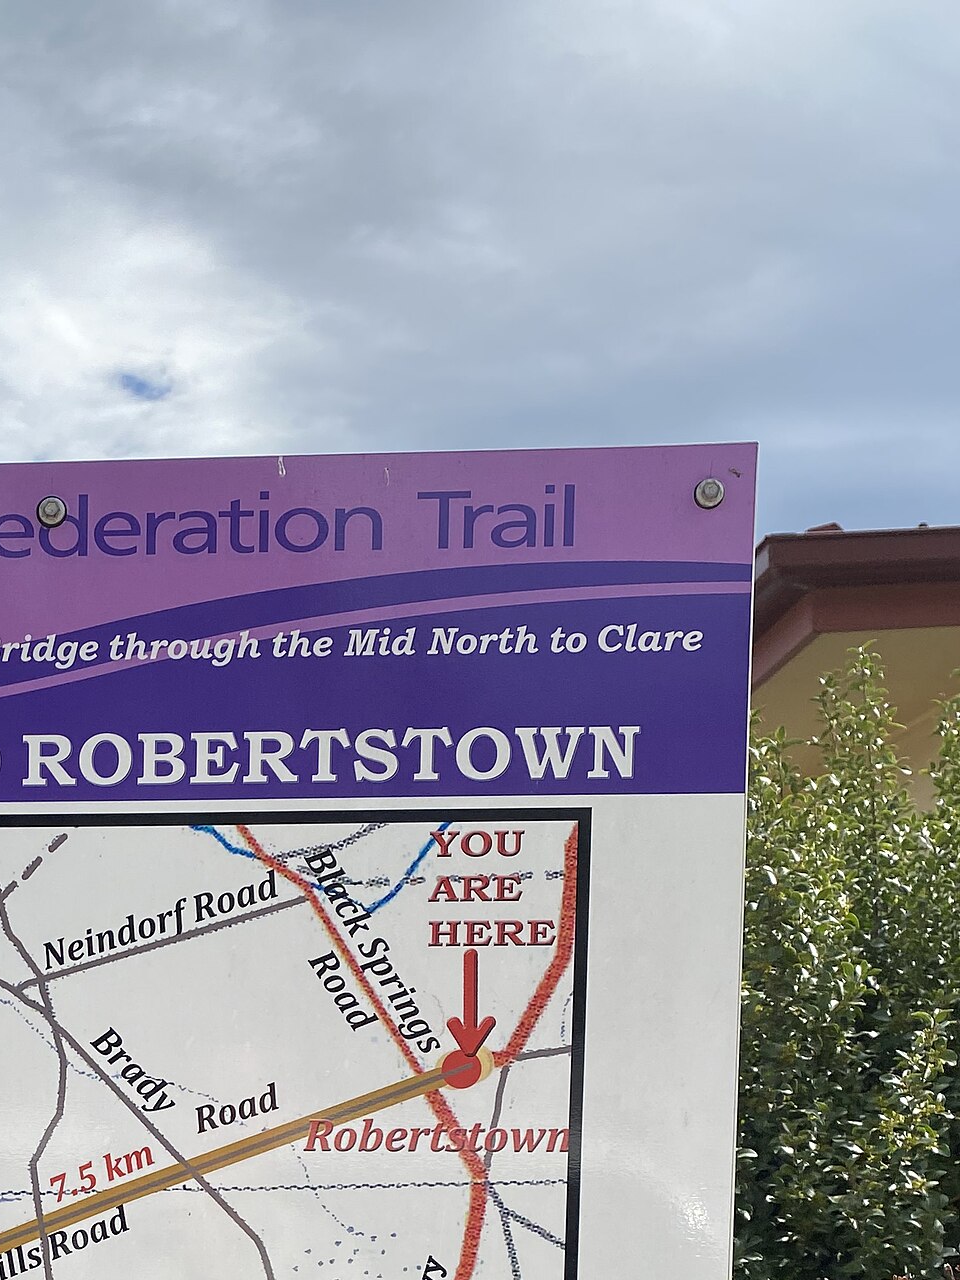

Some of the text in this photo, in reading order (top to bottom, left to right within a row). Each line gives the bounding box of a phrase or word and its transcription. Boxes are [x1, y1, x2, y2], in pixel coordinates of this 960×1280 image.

[417, 484, 576, 549] Trail
[109, 631, 261, 666] through
[272, 629, 333, 658] the
[343, 628, 415, 656] Mid
[427, 626, 541, 655] North
[550, 628, 588, 653] to
[597, 623, 703, 653] Clare
[21, 725, 641, 787] ROBERTSTOWN
[430, 829, 525, 858] YOU
[427, 875, 522, 902] ARE
[42, 870, 279, 970] Neindorf Road
[427, 919, 556, 947] HERE
[304, 848, 442, 1053] Black Springs
[308, 950, 376, 1032] Road
[90, 1026, 176, 1113] Brady
[194, 1083, 280, 1134] Road
[303, 1119, 569, 1152] Robertstown
[50, 1147, 155, 1202] 7.5 km
[48, 1204, 130, 1260] Road
